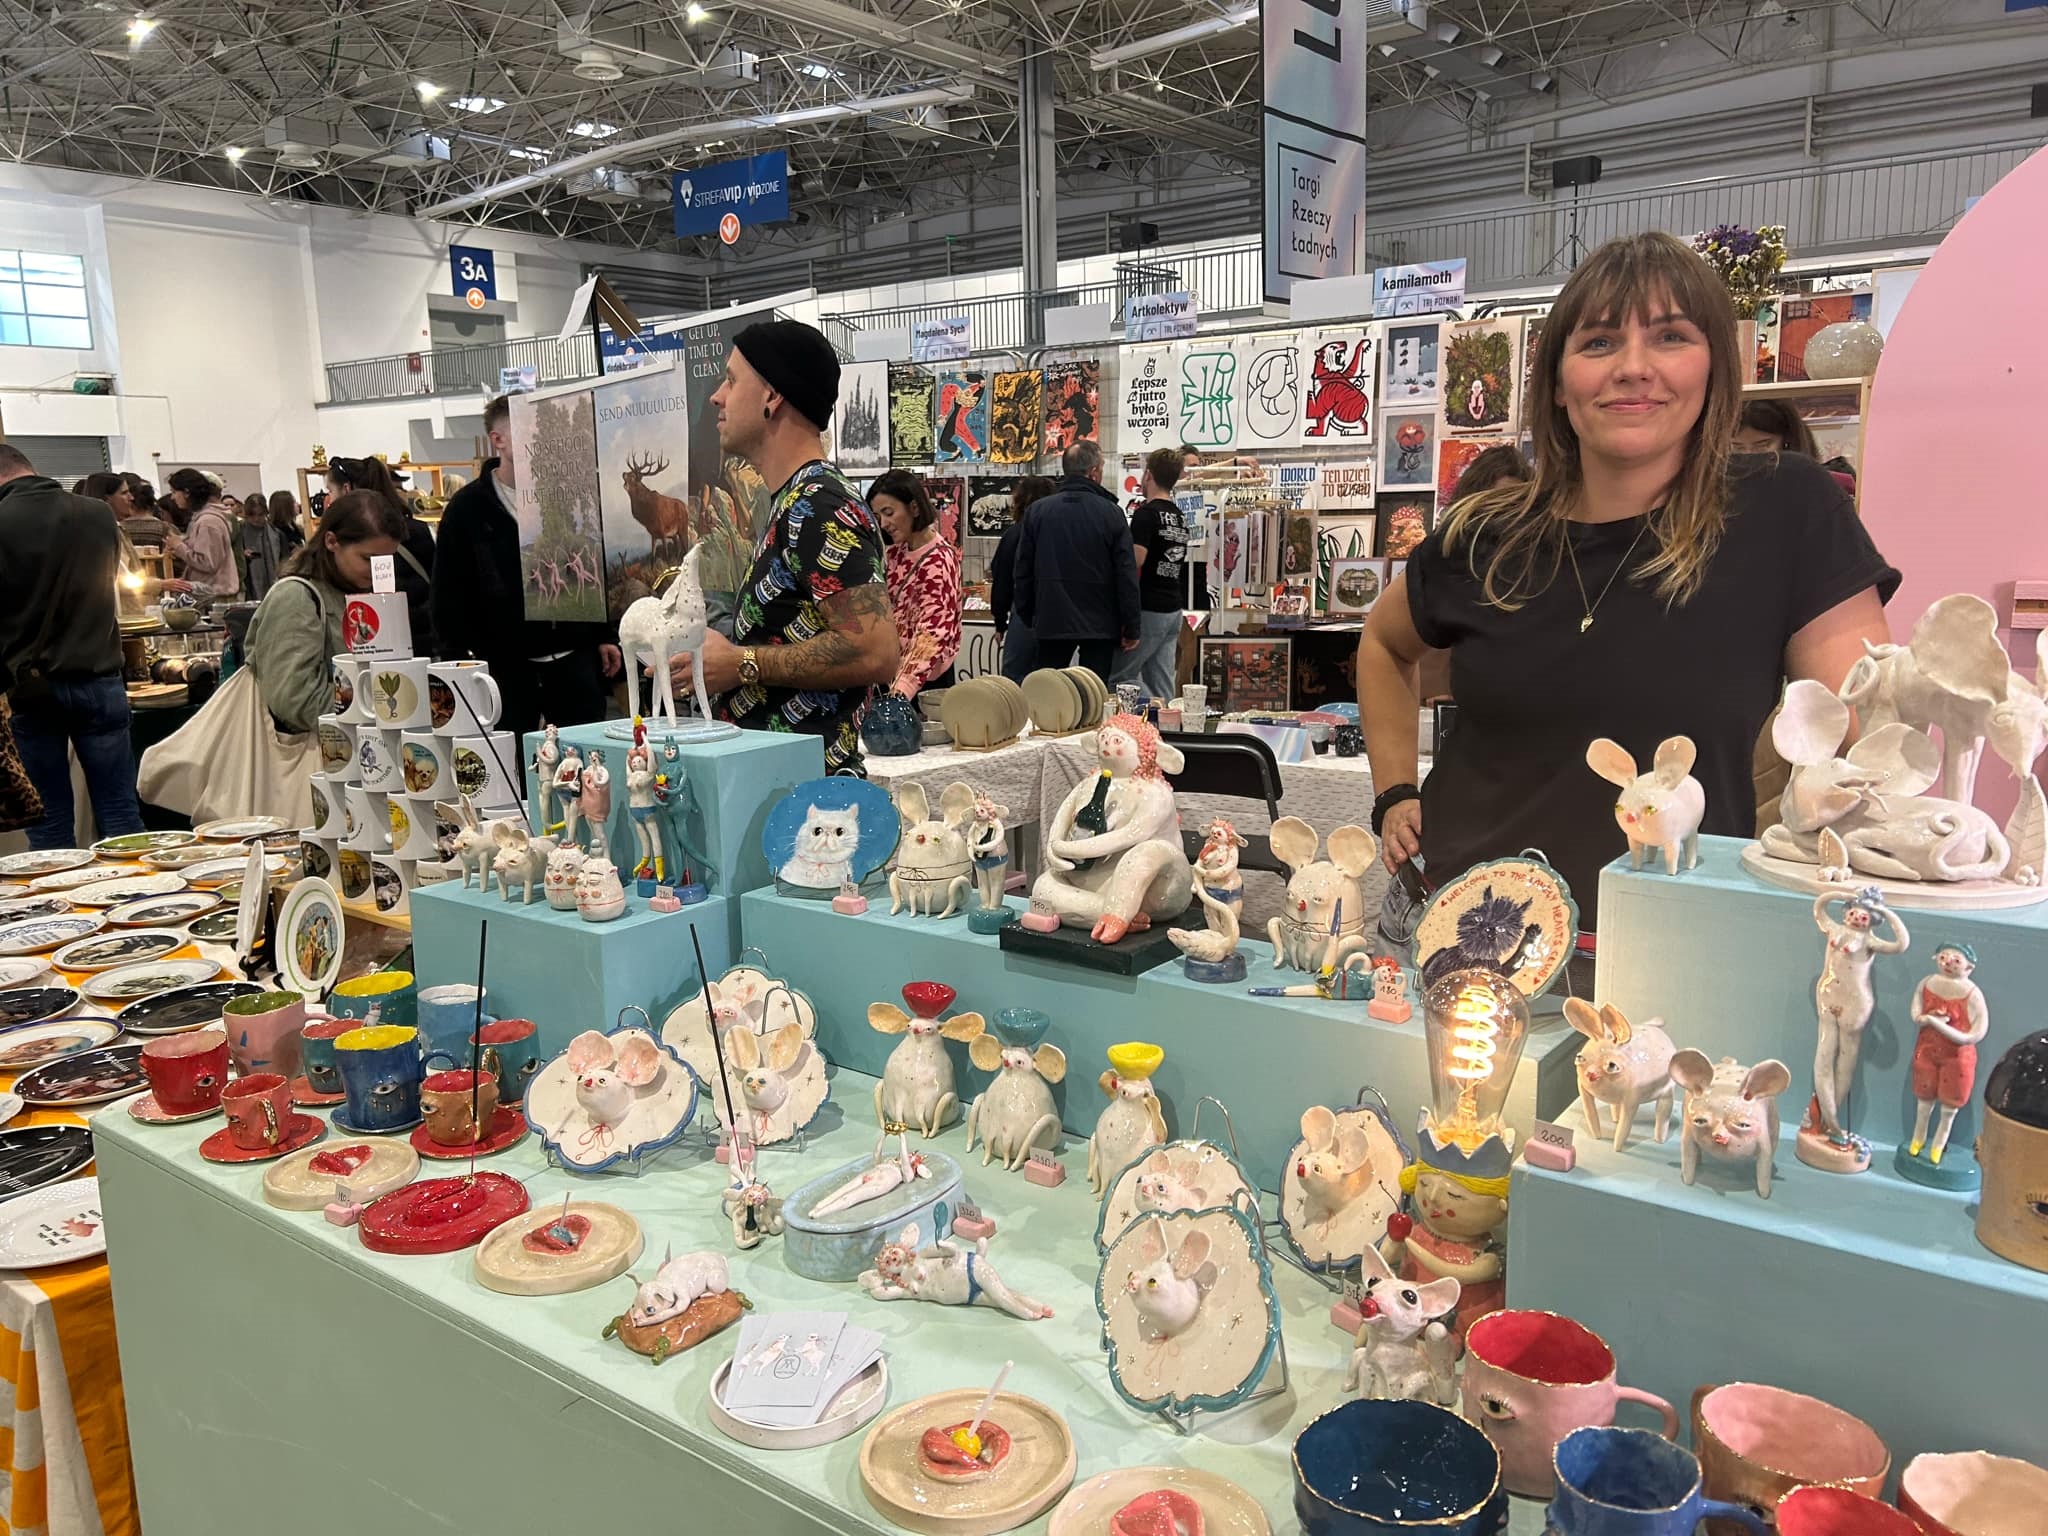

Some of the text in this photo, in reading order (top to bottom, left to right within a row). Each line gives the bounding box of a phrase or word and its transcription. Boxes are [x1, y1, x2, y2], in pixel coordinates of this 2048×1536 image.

[1291, 167, 1321, 200] Targi
[1291, 200, 1332, 233] Rzeczy
[1291, 232, 1337, 262] Ładnych
[460, 256, 488, 283] 3A
[1382, 270, 1452, 291] kamilamoth
[1131, 302, 1189, 319] Artkolektyw
[688, 327, 705, 341] GET
[915, 324, 966, 340] Magdalena Sych
[688, 342, 724, 360] TIME TO
[693, 362, 721, 378] CLEAN
[1139, 389, 1166, 405] jutro
[599, 406, 623, 424] SEND
[1131, 402, 1156, 418] było
[1127, 413, 1170, 430] wczoraj
[1280, 467, 1316, 482] WORLD
[1322, 470, 1341, 484] TEN
[1321, 483, 1335, 498] TO
[1446, 874, 1488, 903] WELCOME
[1493, 870, 1506, 878] TO
[1510, 871, 1528, 881] THE
[1552, 905, 1564, 946] HEARTS
